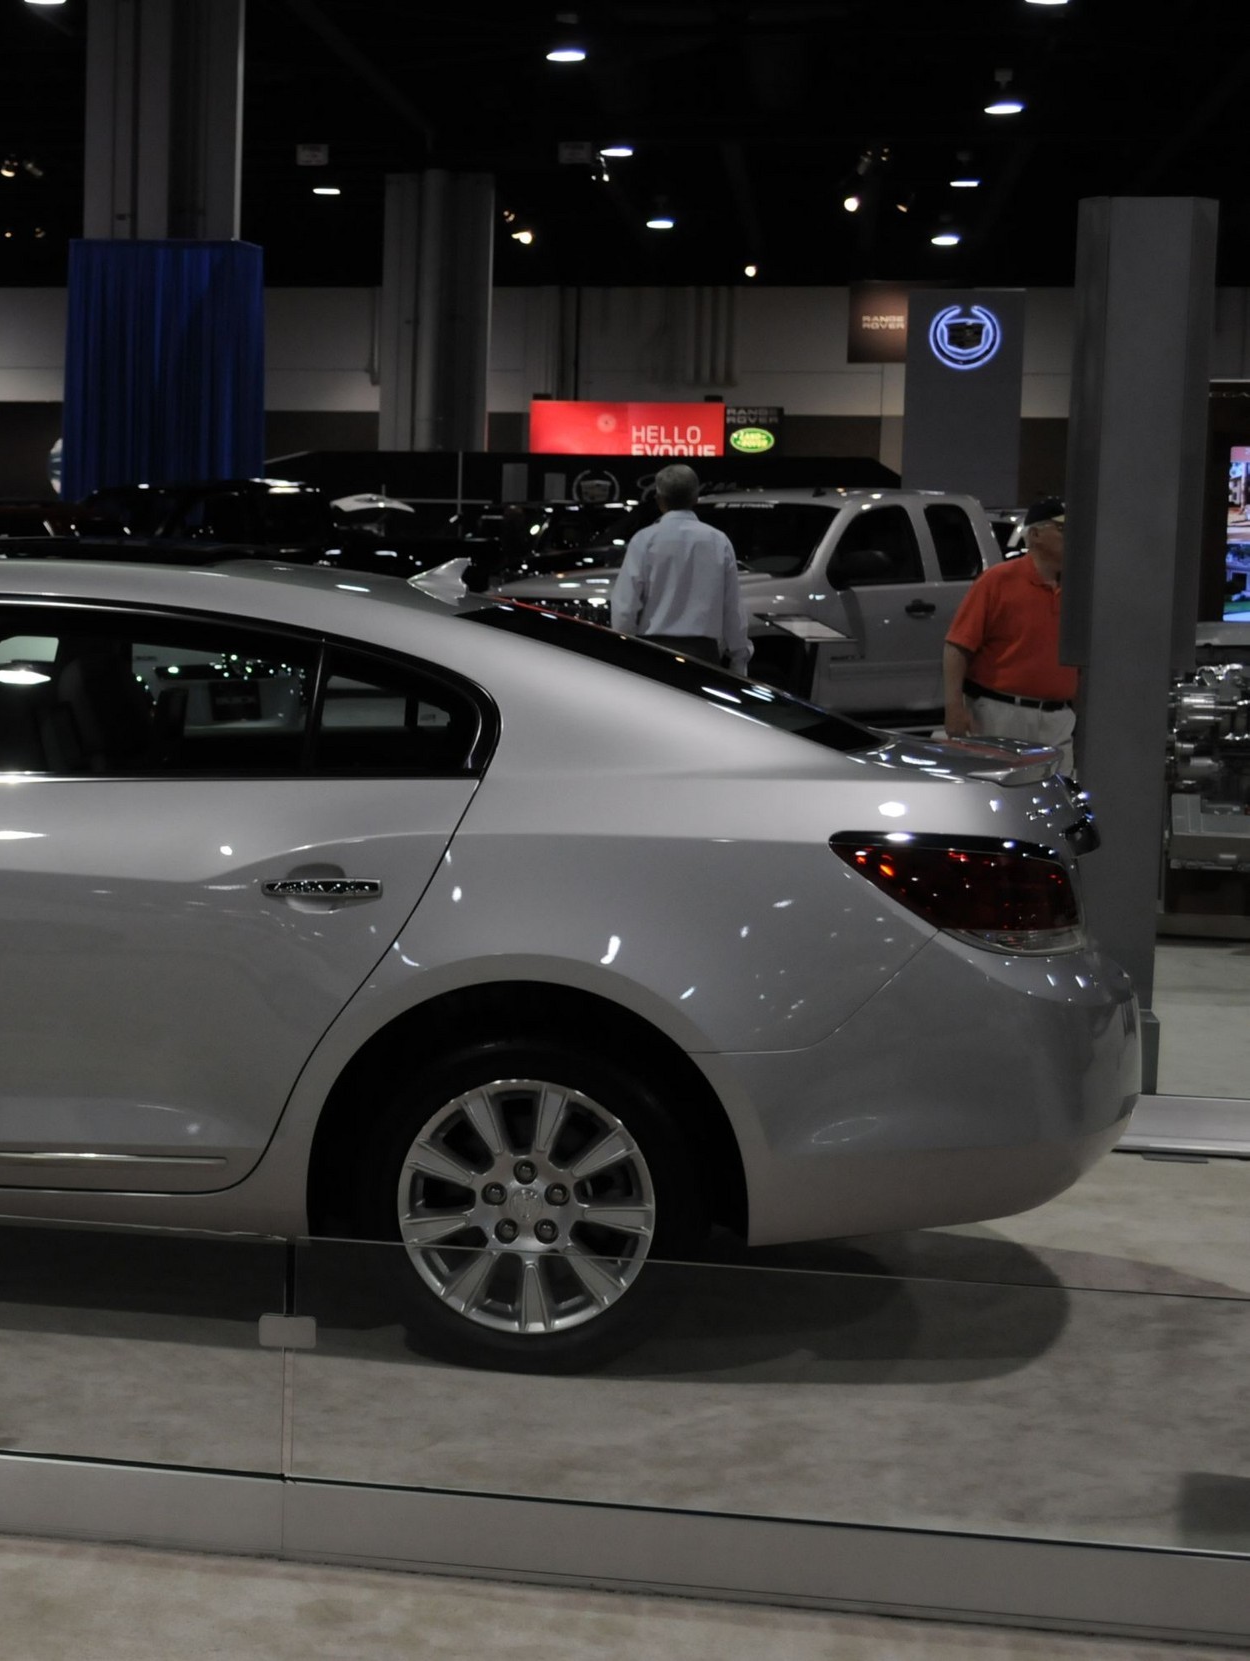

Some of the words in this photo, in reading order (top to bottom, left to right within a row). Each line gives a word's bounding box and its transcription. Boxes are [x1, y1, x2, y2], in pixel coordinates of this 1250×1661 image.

[861, 315, 906, 323] RANGE
[861, 322, 906, 330] ROVER
[631, 425, 701, 445] HELLO
